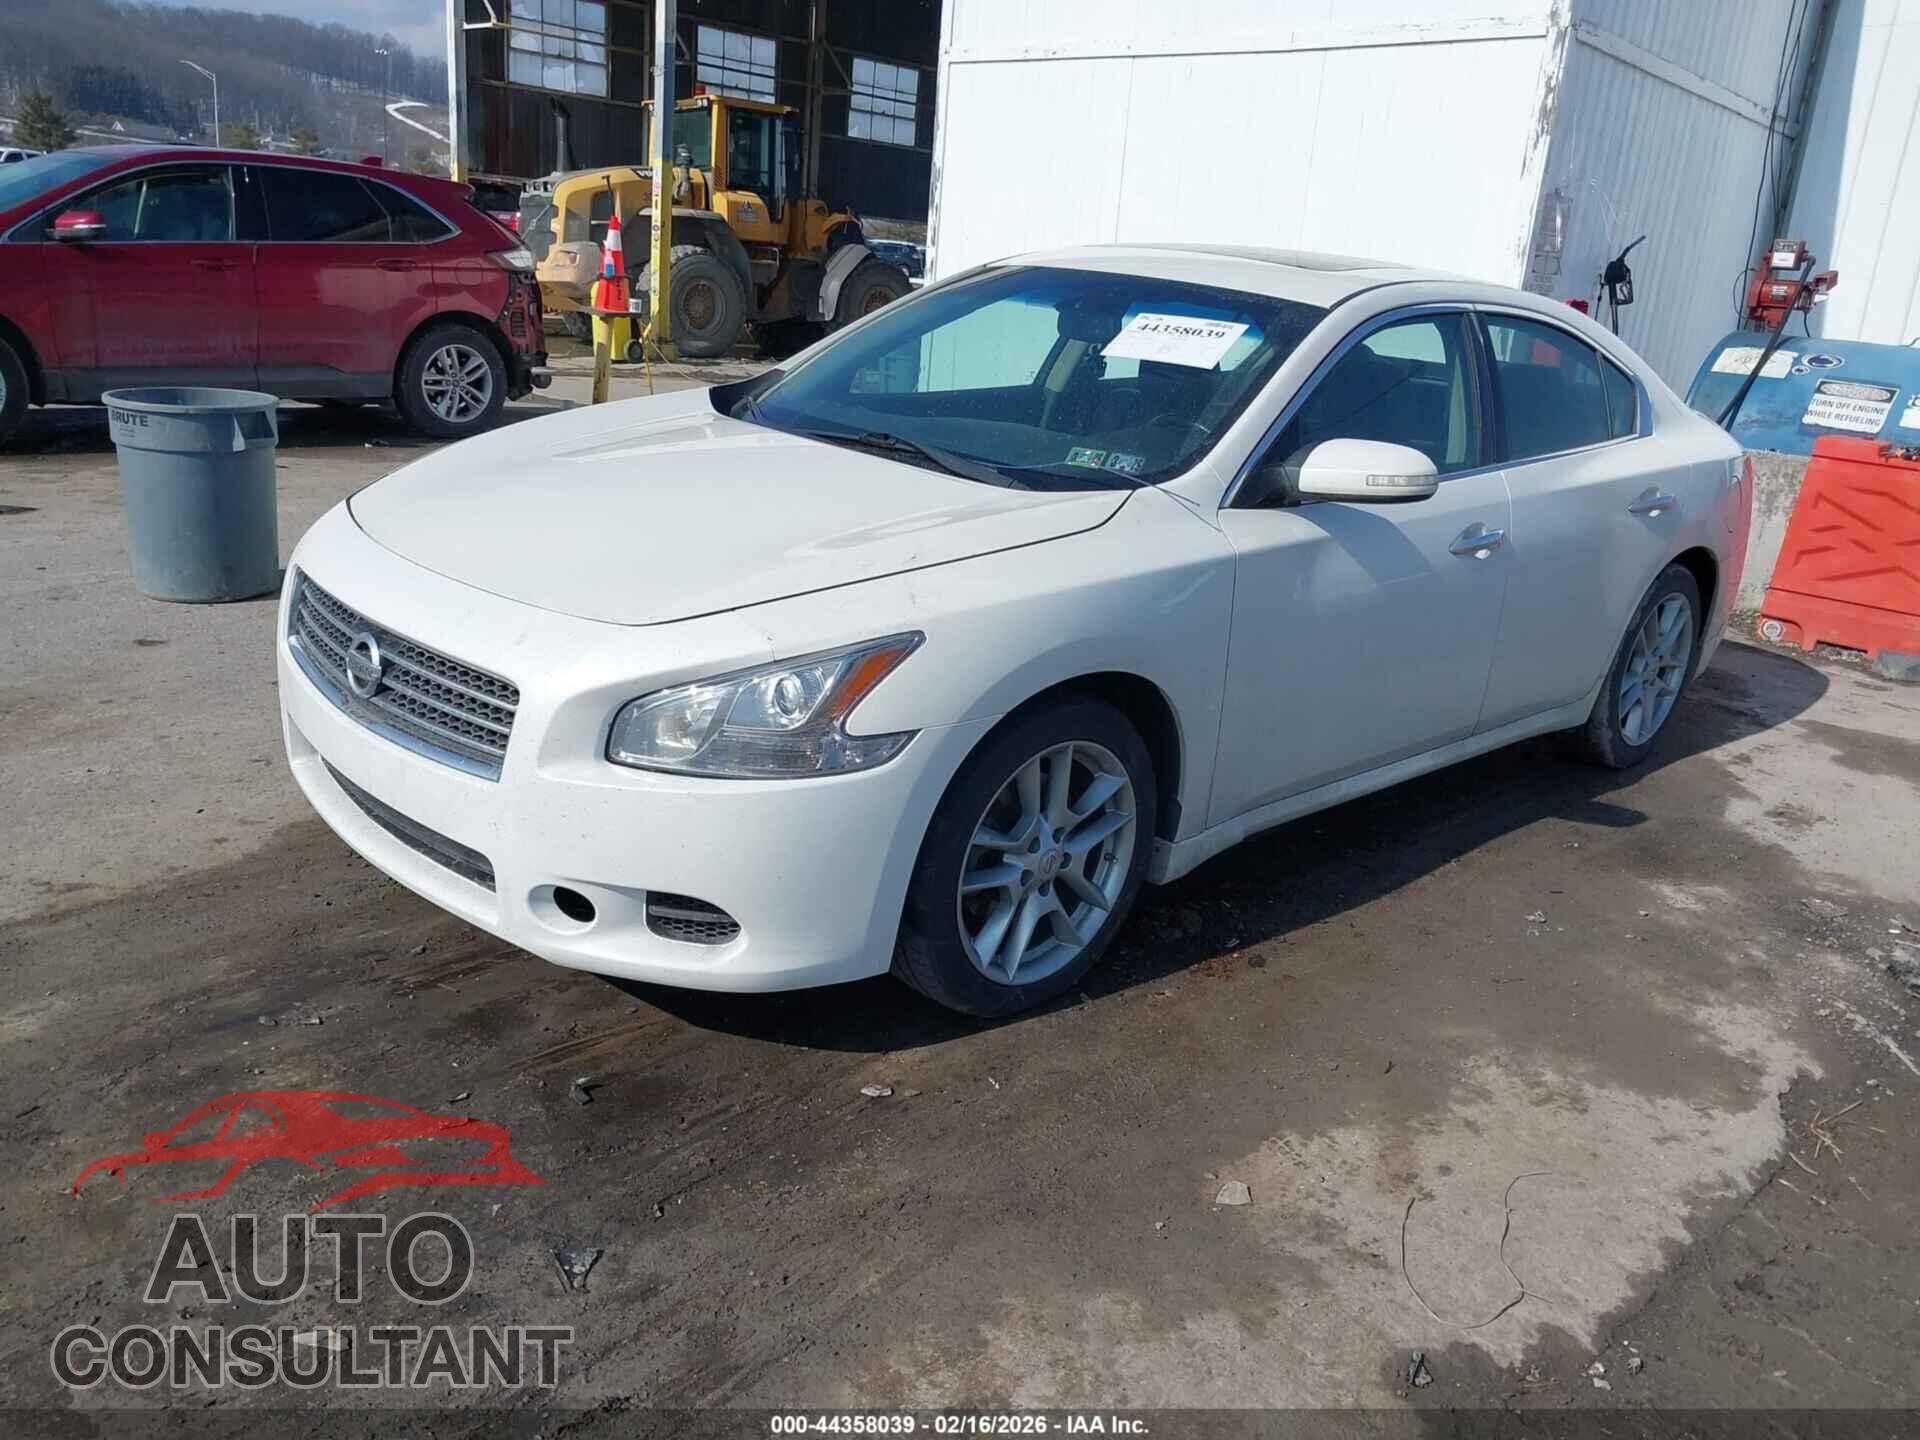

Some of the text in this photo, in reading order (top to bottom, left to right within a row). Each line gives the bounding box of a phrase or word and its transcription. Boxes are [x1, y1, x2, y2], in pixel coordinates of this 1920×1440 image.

[1138, 323, 1226, 339] 44358039
[1811, 398, 1885, 416] TURN OFF ENGINE
[111, 408, 149, 427] BRUTE
[1807, 409, 1881, 426] WHILE REFUELING
